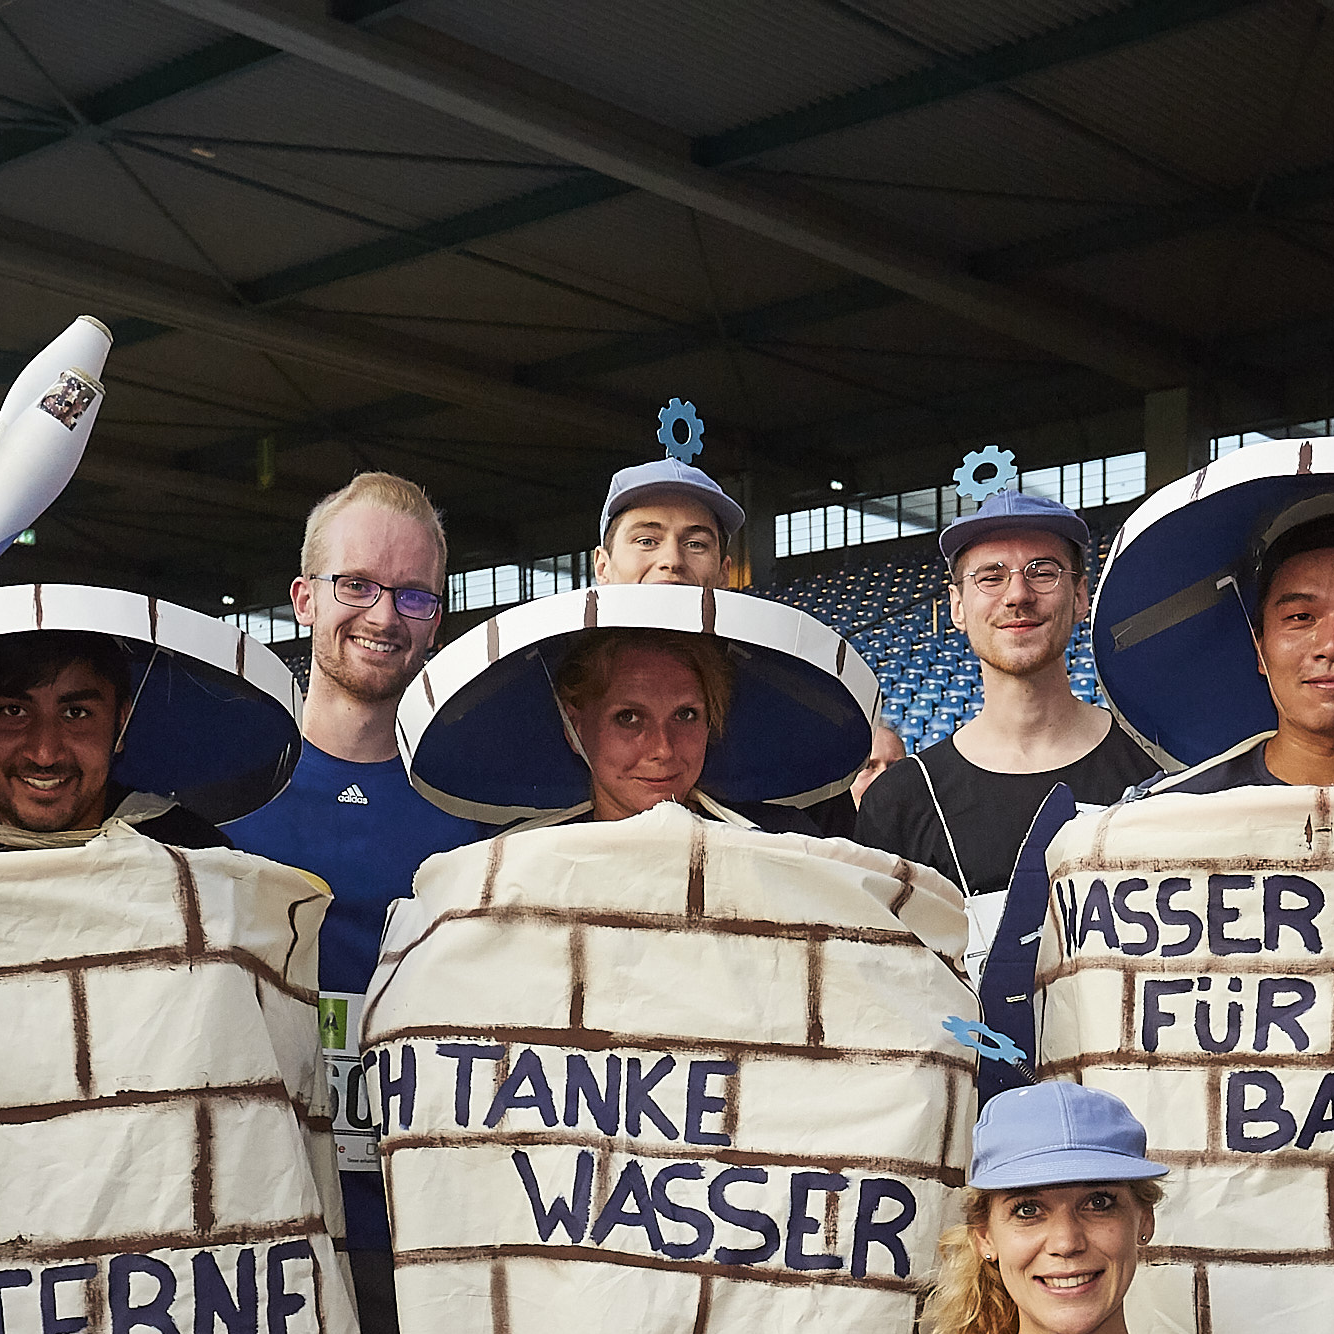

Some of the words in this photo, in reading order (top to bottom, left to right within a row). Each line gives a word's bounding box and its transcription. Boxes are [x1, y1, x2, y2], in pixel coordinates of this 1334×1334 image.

[337, 795, 368, 805] adidas
[1055, 873, 1326, 957] WASSER
[1141, 976, 1317, 1053] FÜR
[435, 1043, 739, 1147] TANKE
[511, 1149, 917, 1280] WASSER
